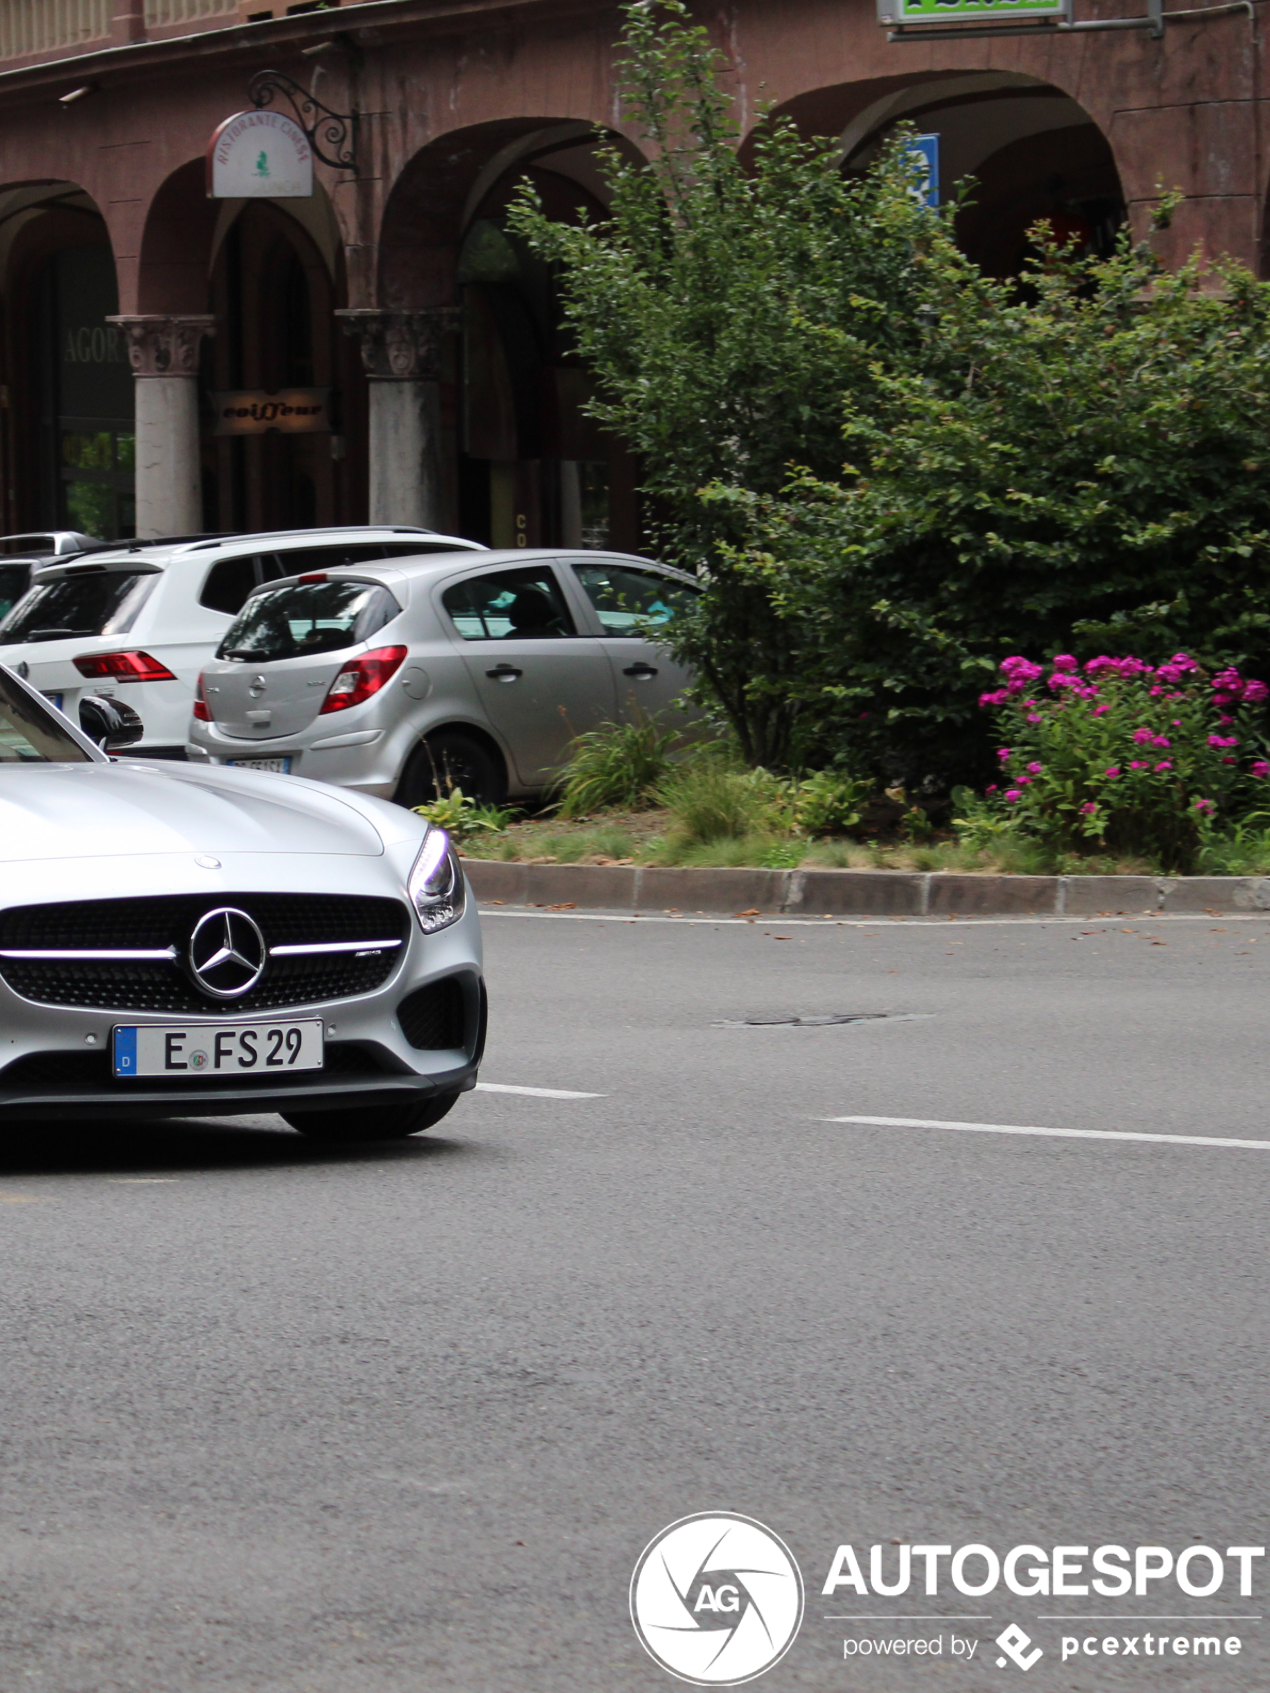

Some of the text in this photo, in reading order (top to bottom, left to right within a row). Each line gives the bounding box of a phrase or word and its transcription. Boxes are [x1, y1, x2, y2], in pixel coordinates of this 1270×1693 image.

[217, 113, 310, 166] RISTORANTE CINESE
[222, 401, 324, 422] coiffeur
[122, 1057, 130, 1068] D
[164, 1032, 188, 1070] E
